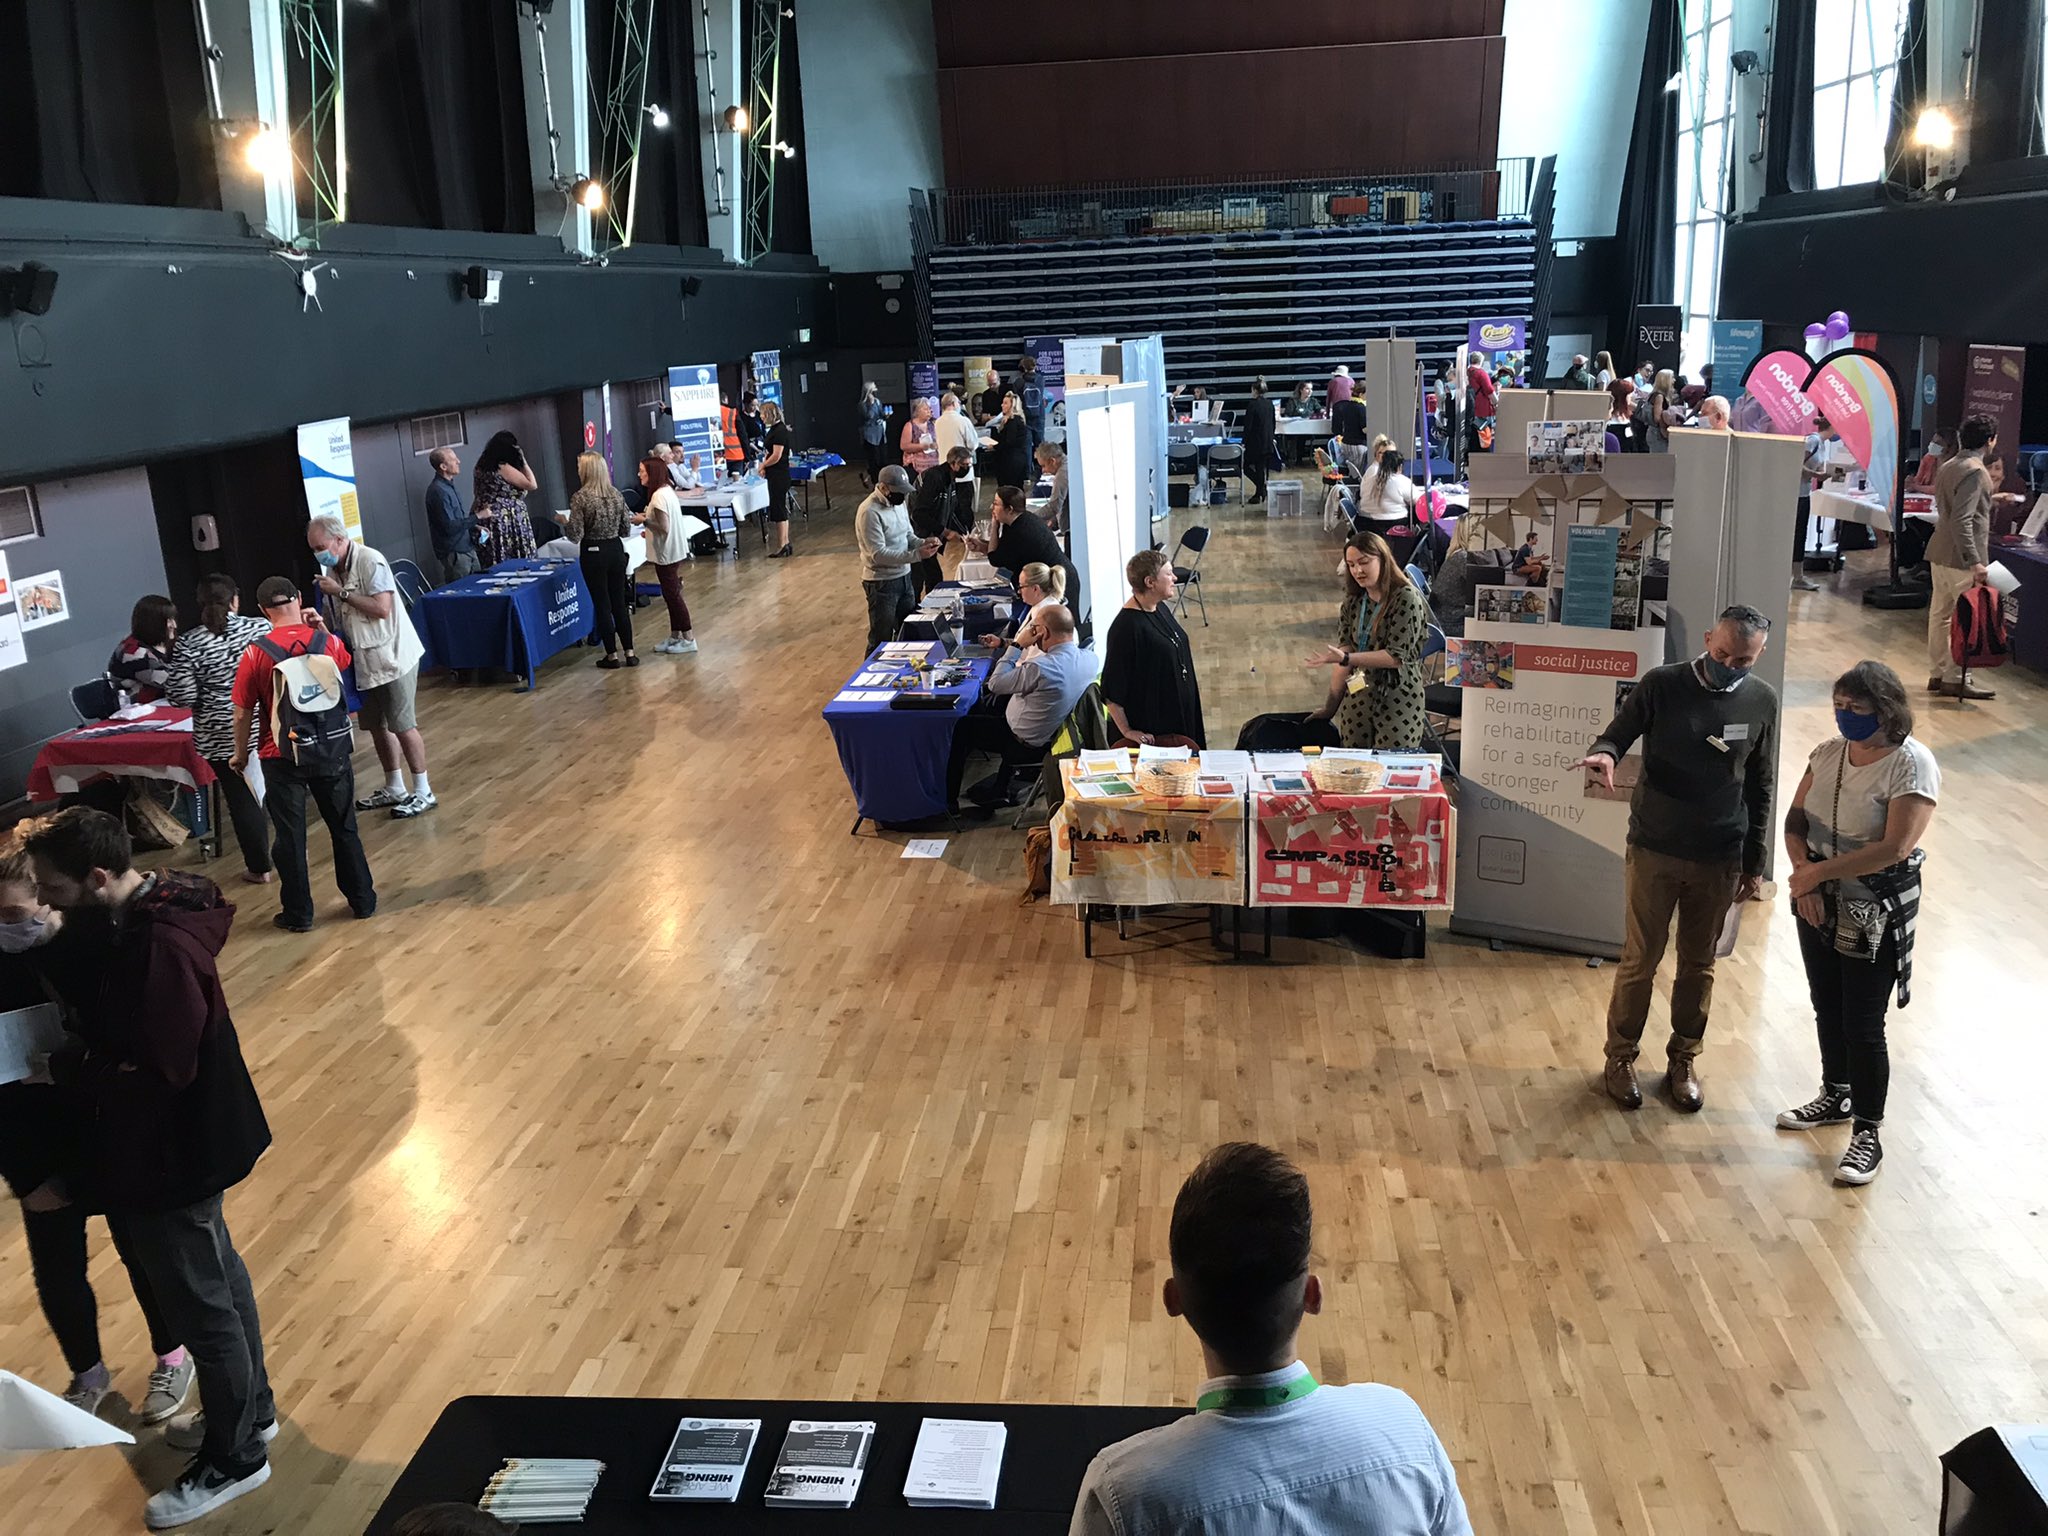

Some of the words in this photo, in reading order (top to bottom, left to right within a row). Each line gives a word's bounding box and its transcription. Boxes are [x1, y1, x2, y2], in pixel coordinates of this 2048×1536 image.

[1640, 326, 1674, 348] EXETER
[674, 387, 715, 402] SAPPHIRE
[1570, 527, 1606, 536] VOLUNTEER
[554, 581, 578, 605] United
[547, 600, 579, 626] Response
[1534, 653, 1577, 668] social
[1578, 653, 1630, 672] justice
[1484, 696, 1601, 726] Reimagining
[1483, 721, 1598, 746] rehabilitatio
[1482, 744, 1508, 762] for
[1513, 750, 1525, 765] a
[1481, 770, 1559, 795] stronger
[1480, 795, 1585, 824] community
[685, 1472, 733, 1483] HIRING
[796, 1474, 845, 1485] HIRING
